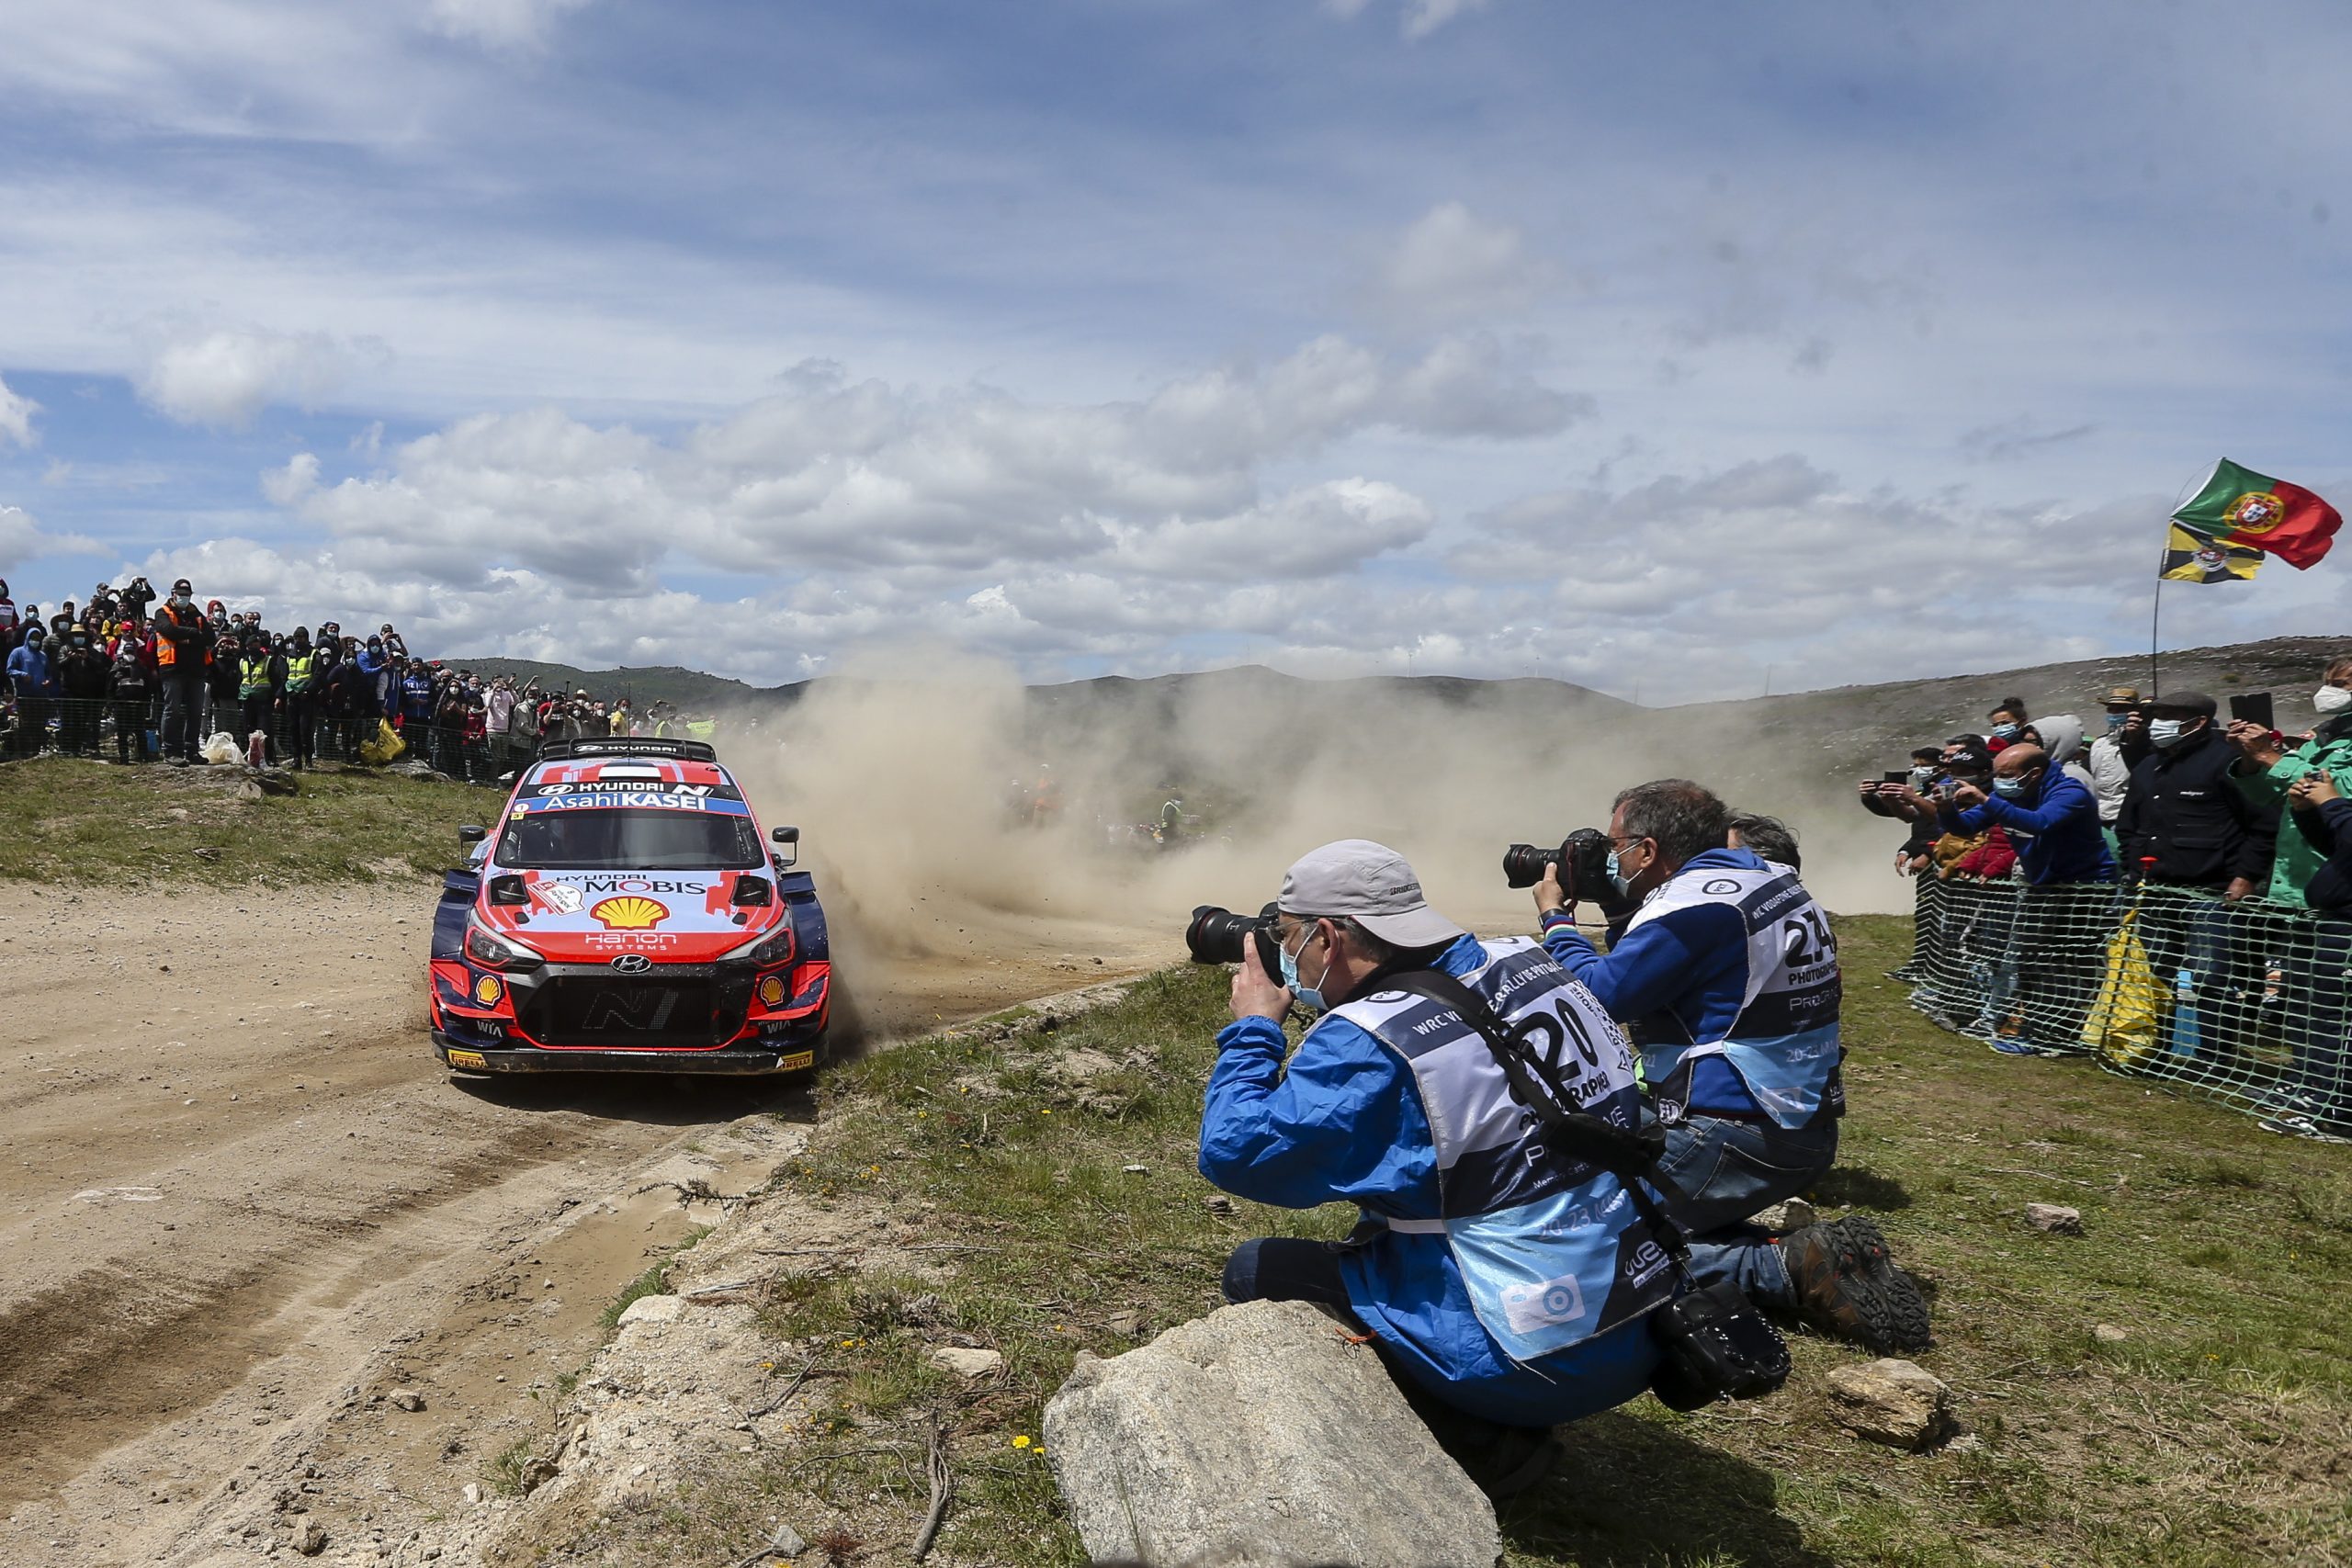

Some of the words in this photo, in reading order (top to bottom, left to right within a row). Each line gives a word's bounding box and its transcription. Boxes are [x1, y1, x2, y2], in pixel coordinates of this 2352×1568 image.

[579, 782, 664, 793] HYUNDAI
[556, 874, 647, 883] HYUNDAI
[585, 880, 707, 895] MOBIS
[1412, 1013, 1449, 1036] WRC
[1509, 998, 1599, 1106] 20
